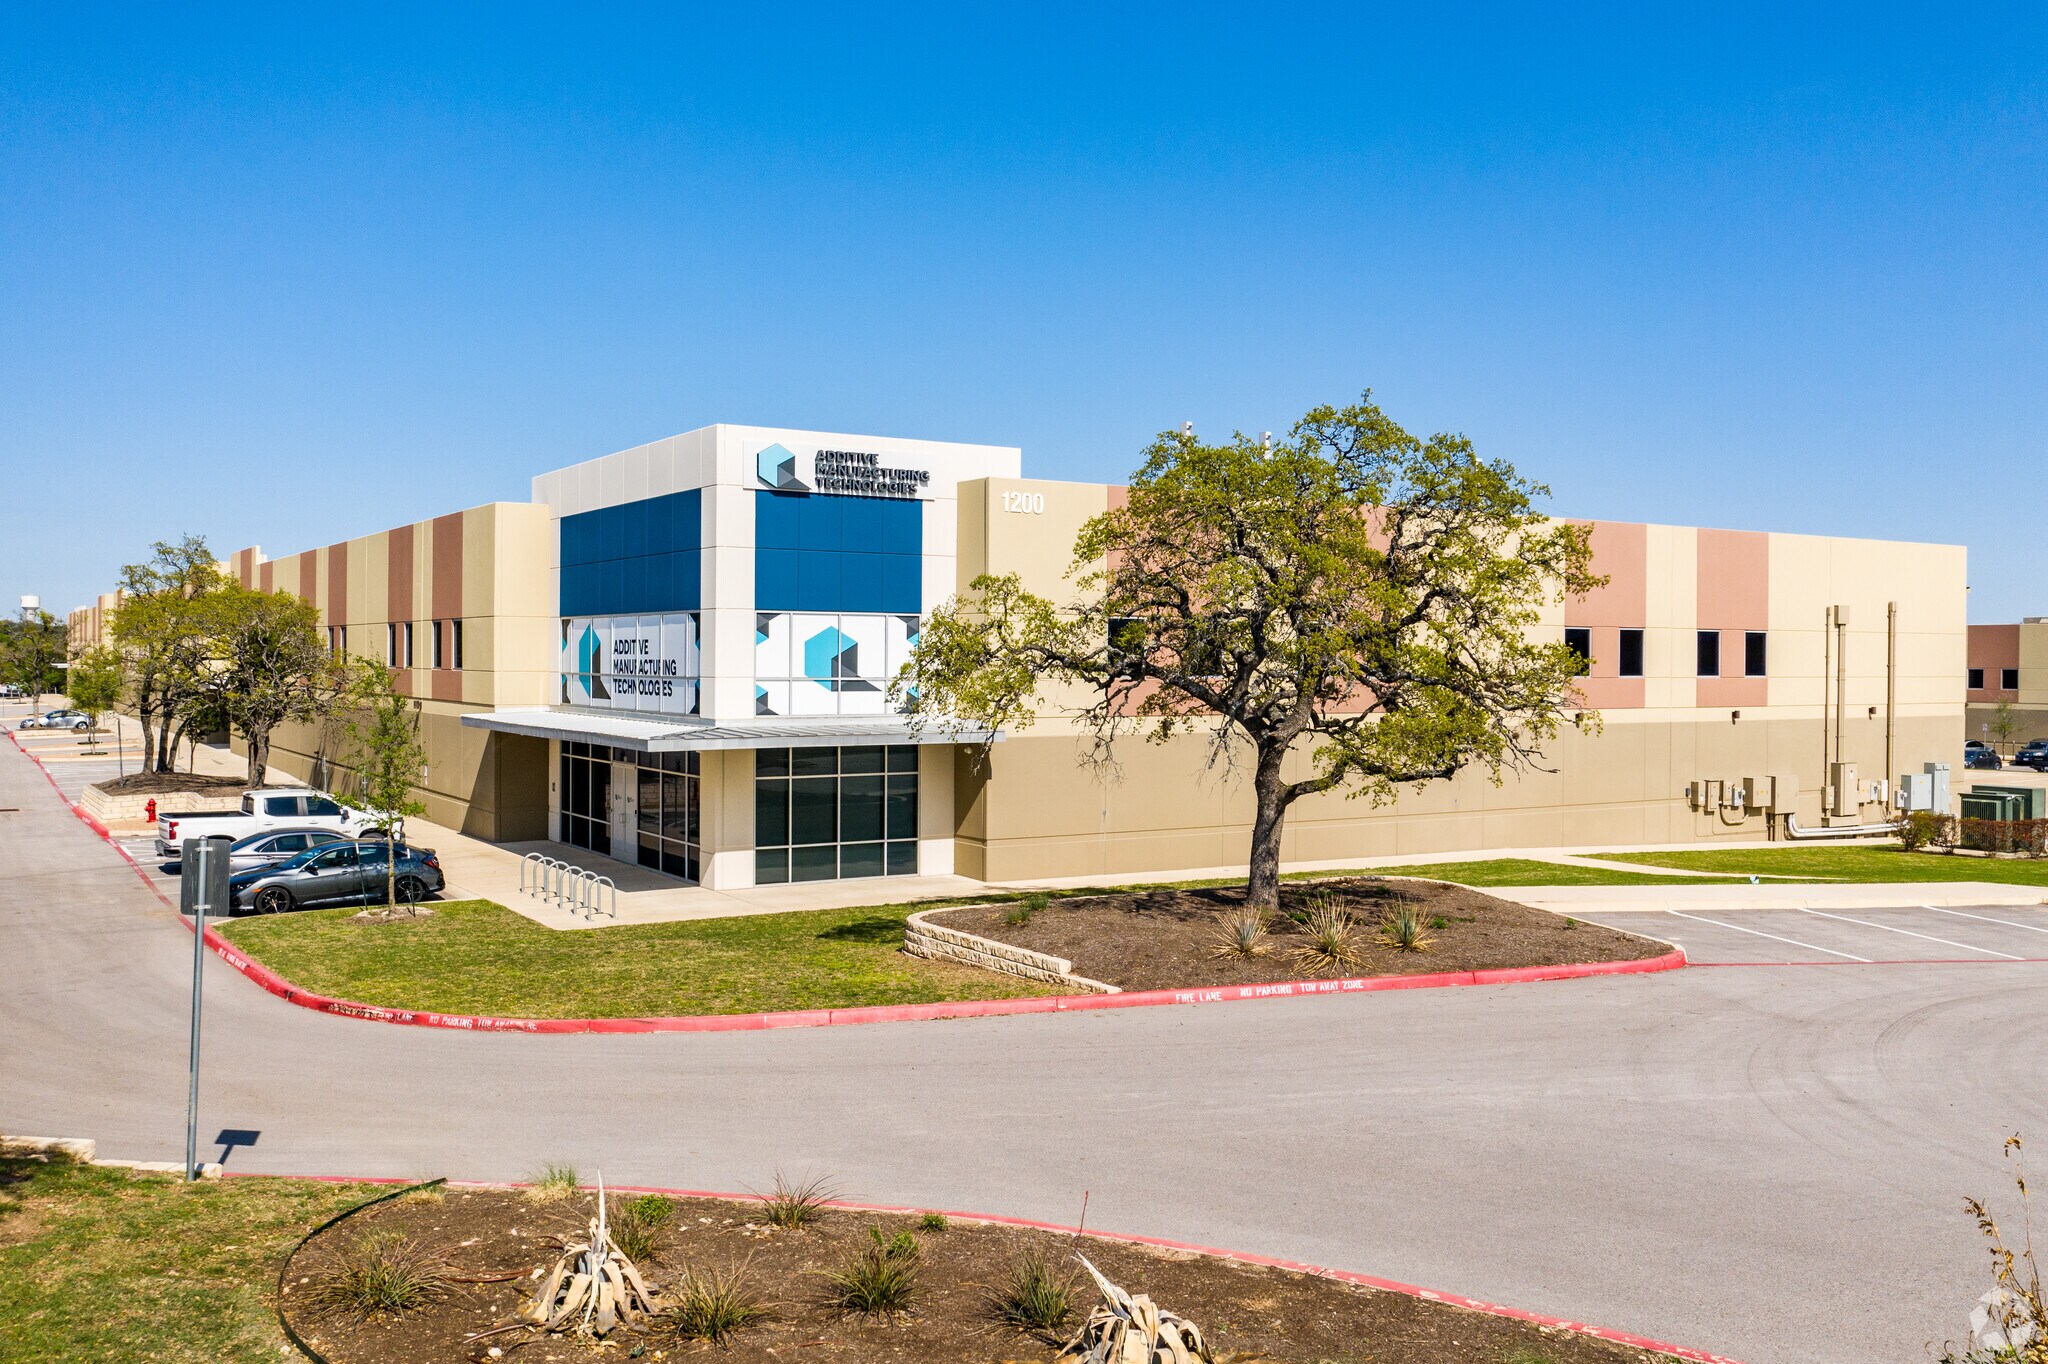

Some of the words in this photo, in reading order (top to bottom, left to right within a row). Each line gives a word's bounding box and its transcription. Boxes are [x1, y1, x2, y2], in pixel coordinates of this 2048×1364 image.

[815, 450, 879, 465] ADDITIVE
[815, 464, 930, 482] MANUFACTURING
[815, 477, 918, 494] TECHNOLOGIES
[1001, 490, 1044, 515] 1200
[613, 639, 649, 655] ADDITVE
[613, 678, 673, 697] TECHNOLOGES
[1175, 993, 1196, 1003] FIRE
[1199, 991, 1222, 1002] LANE
[1240, 987, 1253, 997] NO
[1256, 984, 1292, 996] PARKING
[1300, 982, 1317, 993] TOW
[1319, 981, 1339, 991] AWAY
[1342, 979, 1364, 989] ZONE
[441, 1016, 474, 1029] PARKING
